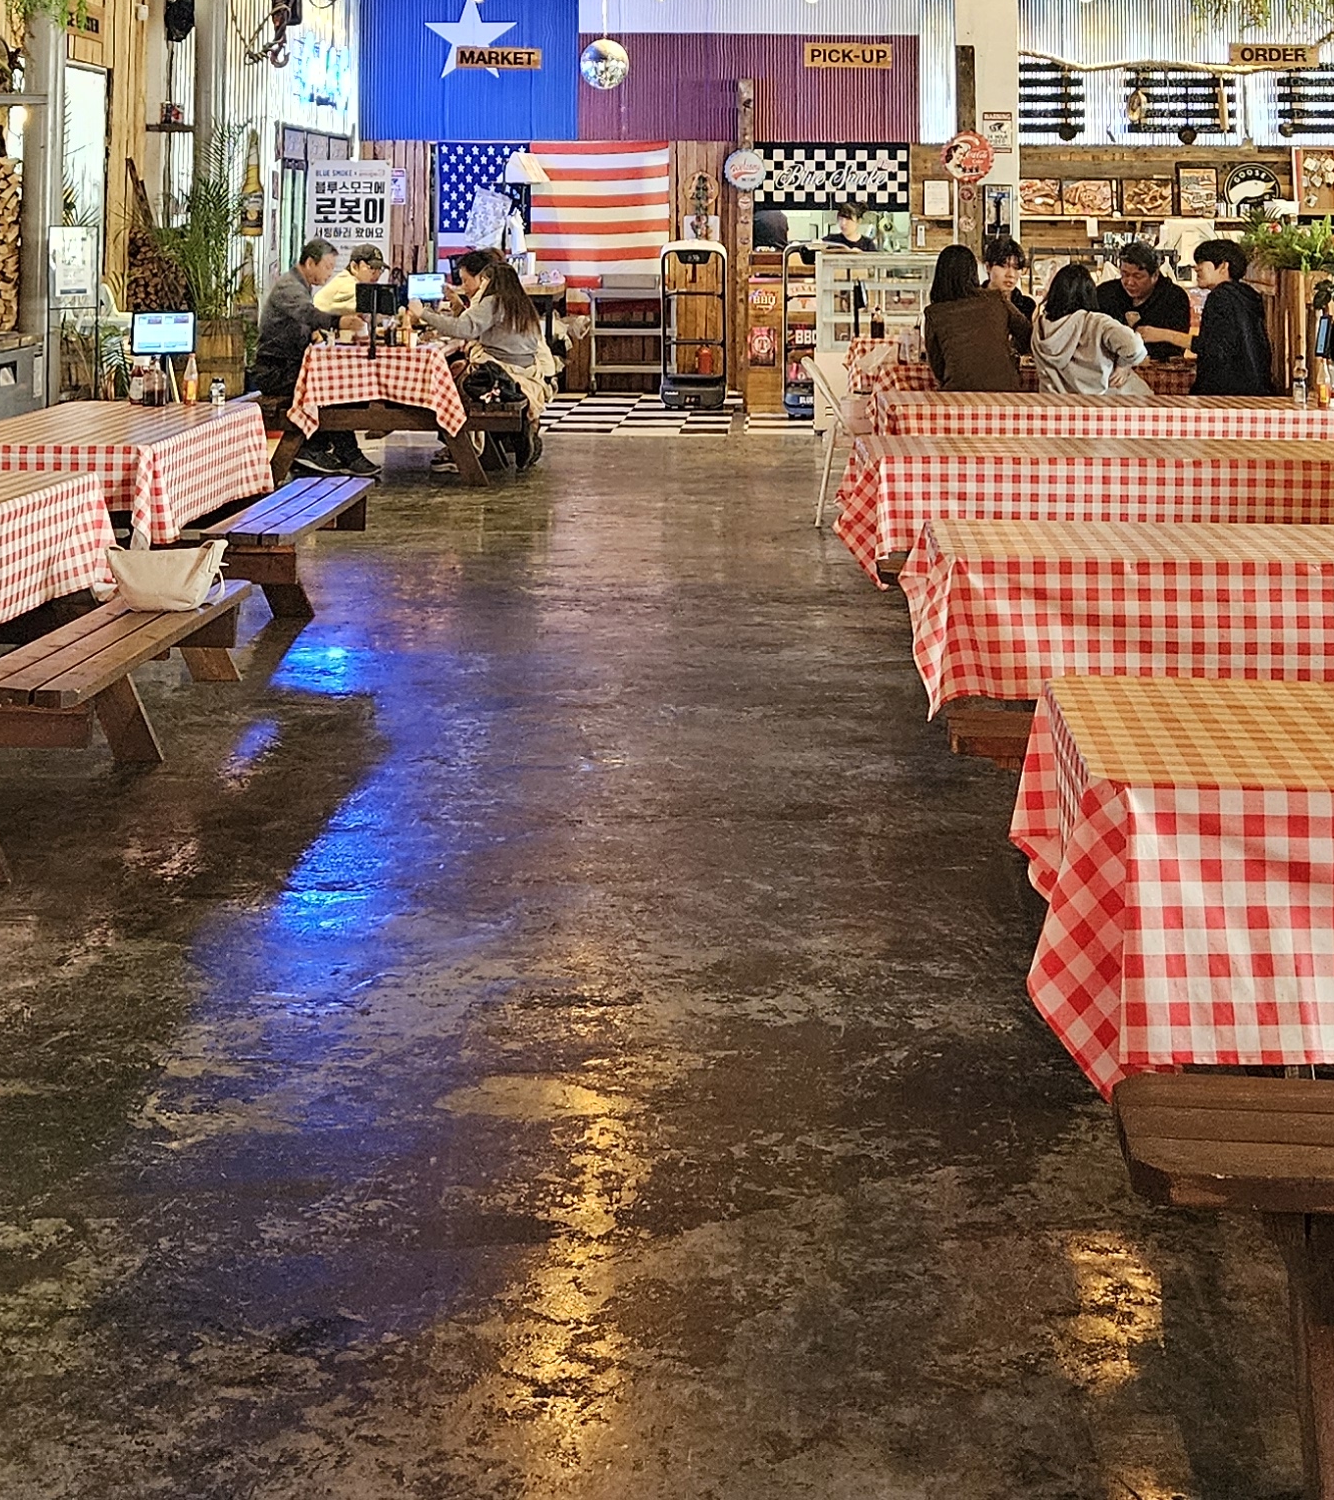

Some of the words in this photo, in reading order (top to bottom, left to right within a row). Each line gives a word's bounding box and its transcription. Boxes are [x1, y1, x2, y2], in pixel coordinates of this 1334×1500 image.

[459, 50, 535, 66] MARKET
[810, 48, 887, 64] PICK-UP
[1240, 47, 1308, 62] ORDER
[315, 169, 330, 177] BLUE
[332, 169, 352, 177] SMOKE
[774, 163, 826, 189] Blue
[829, 161, 887, 189] Smoke
[1233, 169, 1267, 184] GOOSE
[315, 181, 385, 194] 블루스모크에
[314, 197, 384, 224] 로봇이
[314, 227, 351, 238] 서빙하러
[355, 227, 384, 238] 왔어요
[753, 295, 776, 306] BBQ
